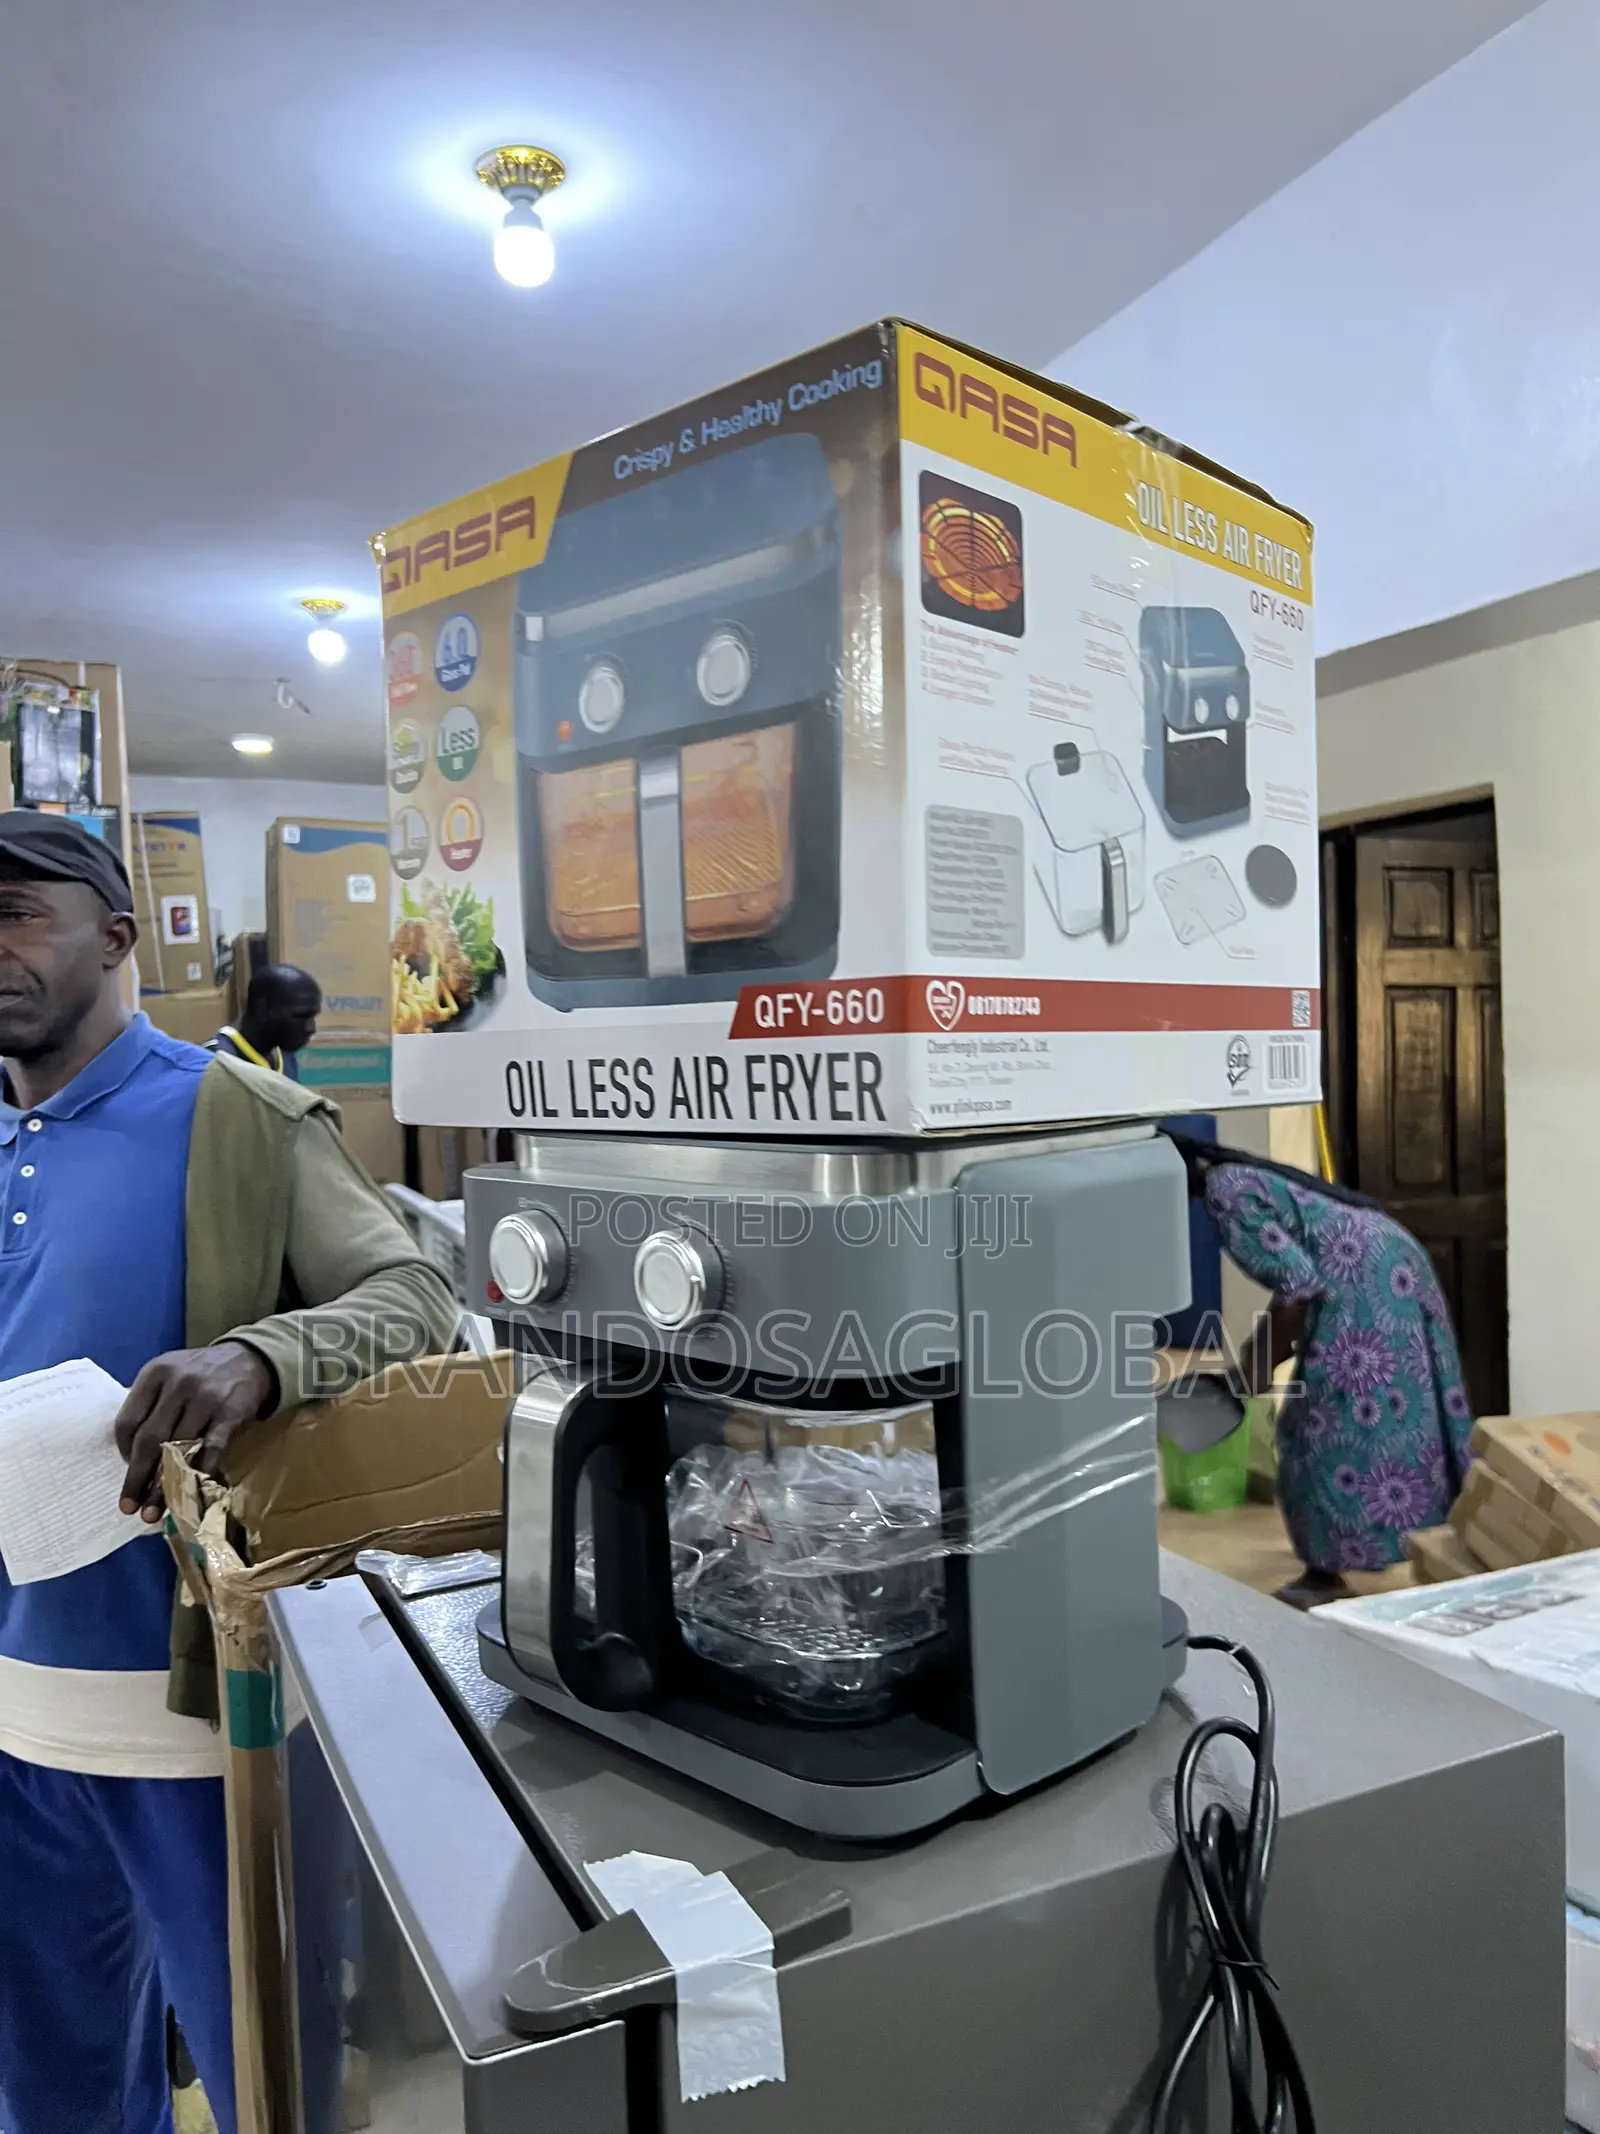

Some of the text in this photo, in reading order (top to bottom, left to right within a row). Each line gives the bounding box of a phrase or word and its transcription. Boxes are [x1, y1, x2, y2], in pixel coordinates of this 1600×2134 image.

[614, 359, 883, 480] Crispy & Healthy Cooking
[914, 351, 1077, 468] QASA
[1137, 481, 1304, 592] OIL LESS AIR FRYER
[1250, 589, 1304, 631] QFY-660
[754, 987, 884, 1029] QFY-660
[505, 1051, 888, 1123] OIL LESS AIR FRYER
